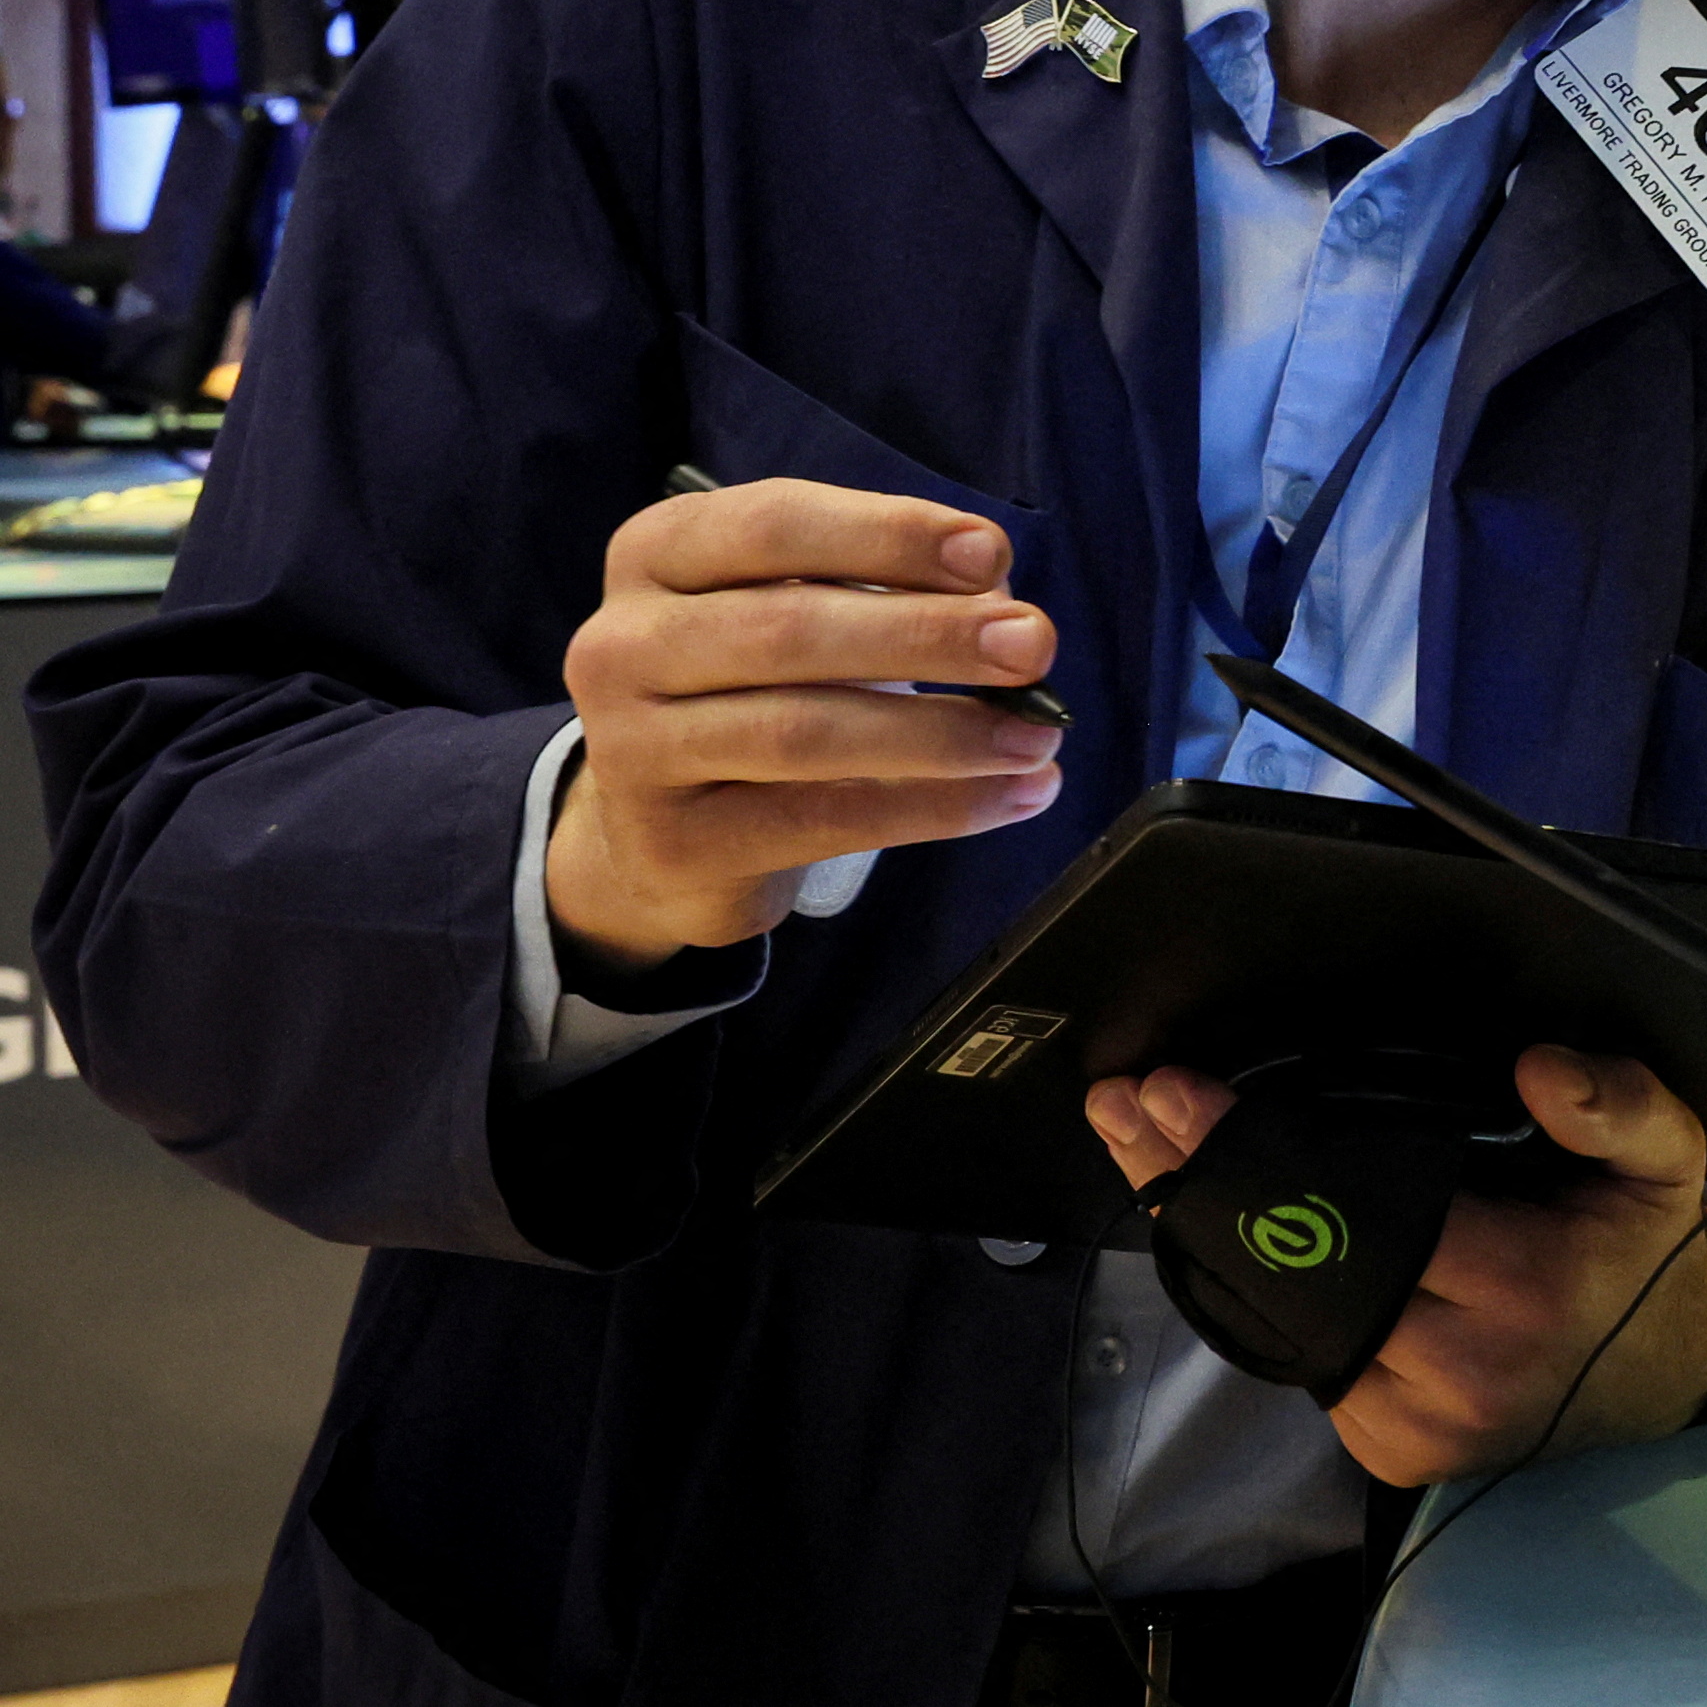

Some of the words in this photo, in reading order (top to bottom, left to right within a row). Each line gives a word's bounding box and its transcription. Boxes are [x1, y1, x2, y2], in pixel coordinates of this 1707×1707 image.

[1073, 33, 1107, 61] NYSE
[1541, 61, 1623, 151] LIVERMORE
[1618, 149, 1678, 219] TRADING
[1602, 71, 1686, 161] GREGORY
[1681, 162, 1707, 192] M.
